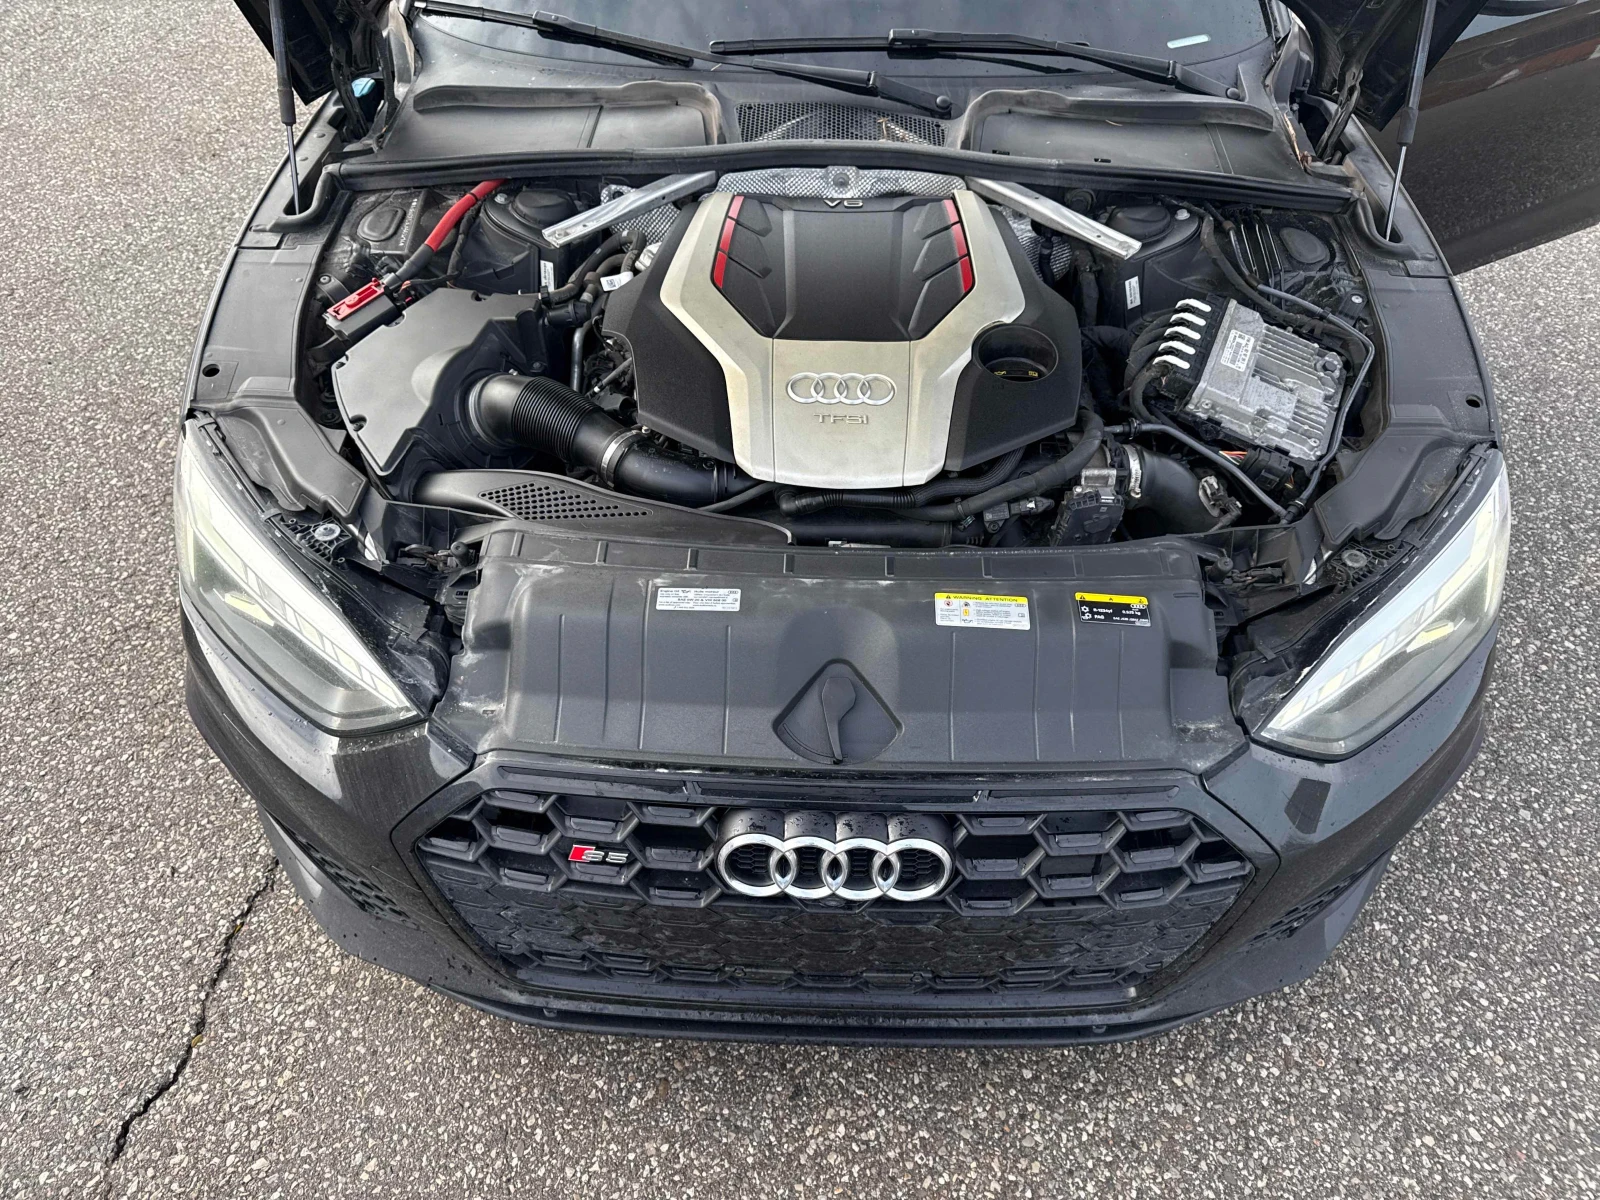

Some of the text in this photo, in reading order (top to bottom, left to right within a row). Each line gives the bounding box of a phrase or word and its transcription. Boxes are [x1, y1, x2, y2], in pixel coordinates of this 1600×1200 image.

[823, 199, 863, 208] V6
[813, 413, 869, 424] TFSI
[580, 848, 629, 864] S5
